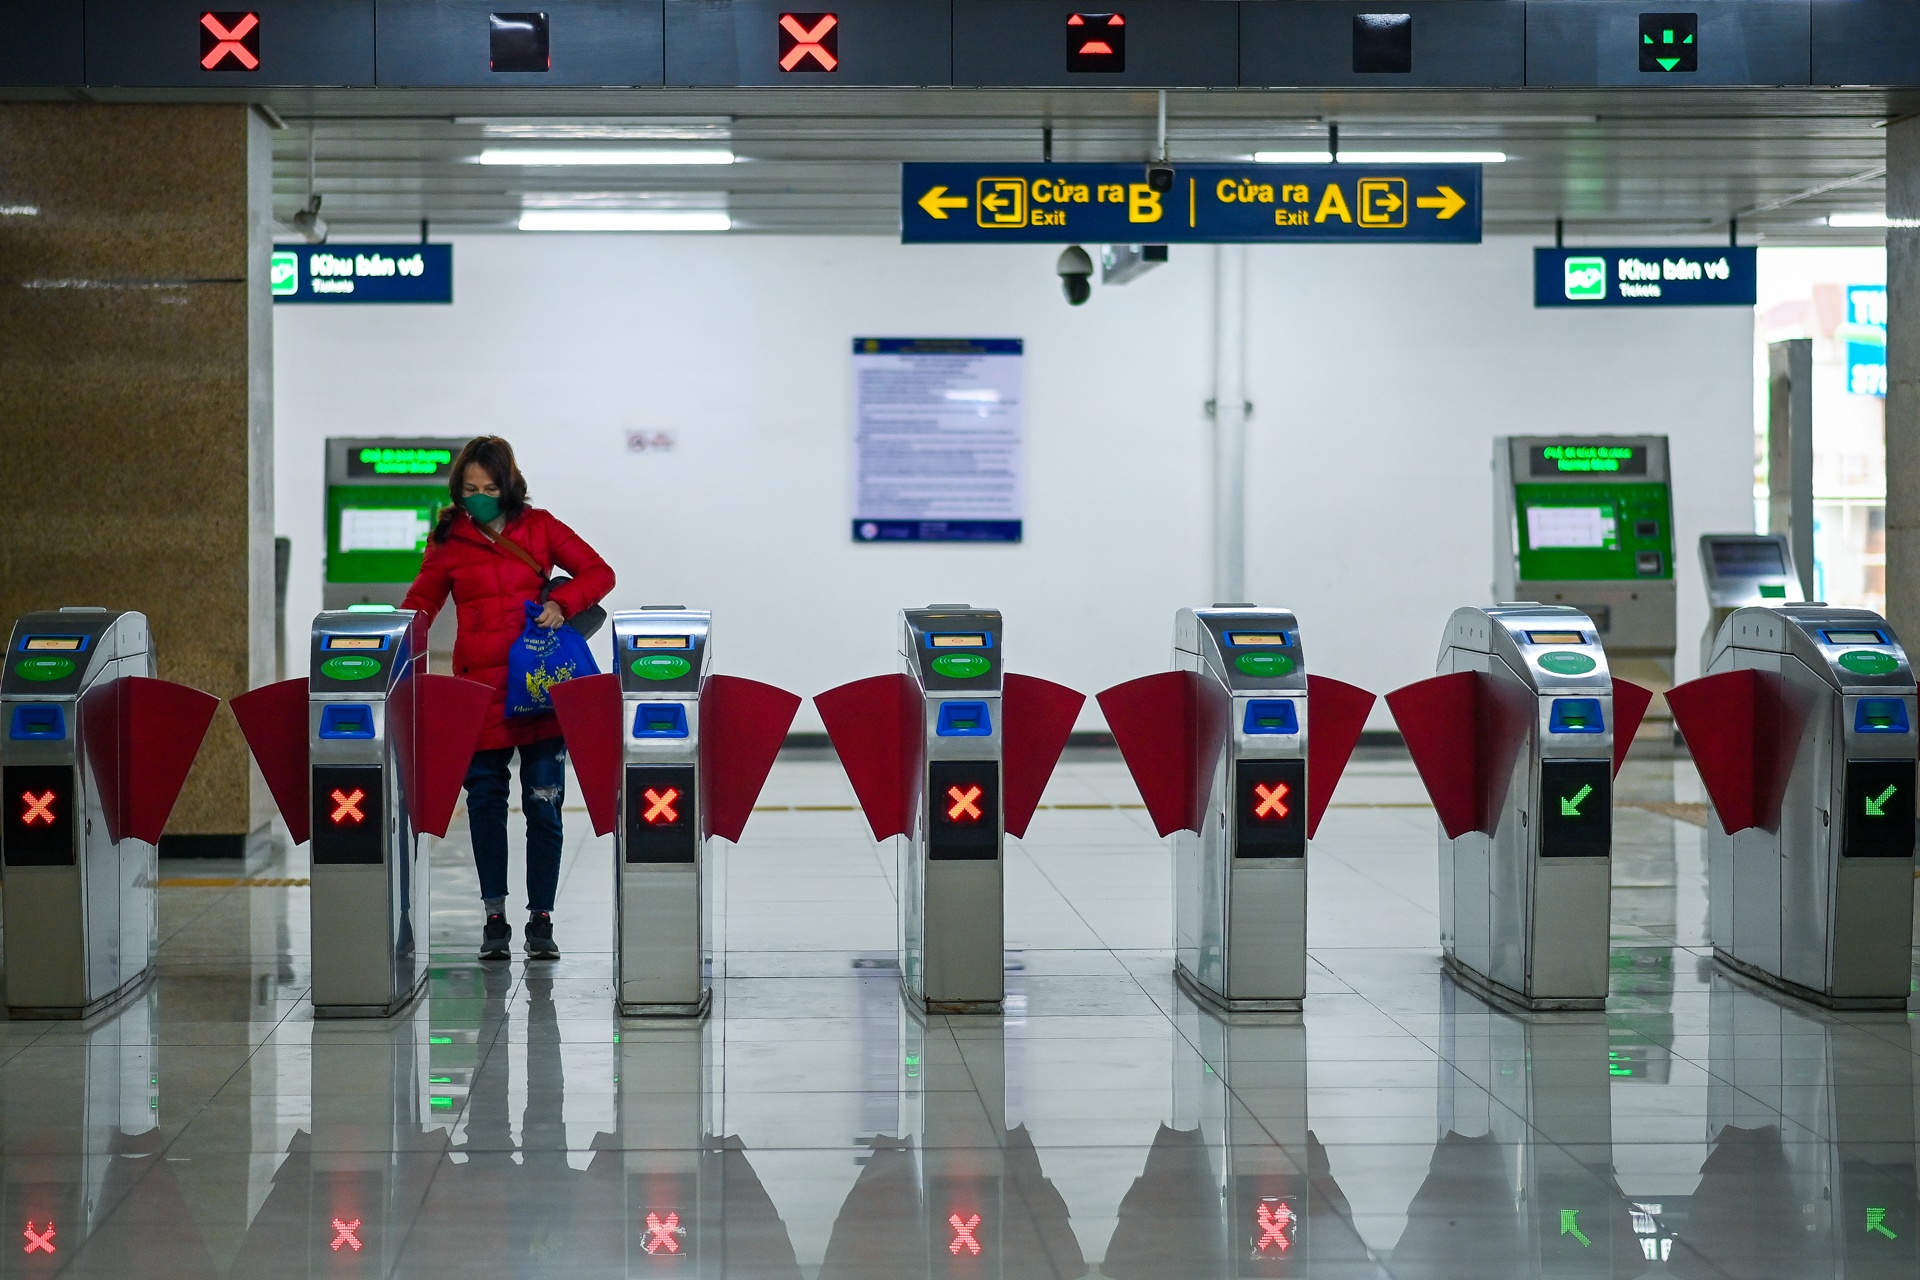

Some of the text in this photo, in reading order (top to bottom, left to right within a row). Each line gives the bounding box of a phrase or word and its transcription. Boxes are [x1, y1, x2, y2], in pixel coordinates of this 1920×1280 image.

[1031, 178, 1163, 223] Cửa ra B
[1216, 178, 1353, 223] Cửa ra A
[1031, 209, 1067, 226] Exit
[1275, 209, 1310, 226] Exit
[310, 253, 354, 277] Khu
[1618, 257, 1660, 281] Khu
[1662, 257, 1702, 281] bán
